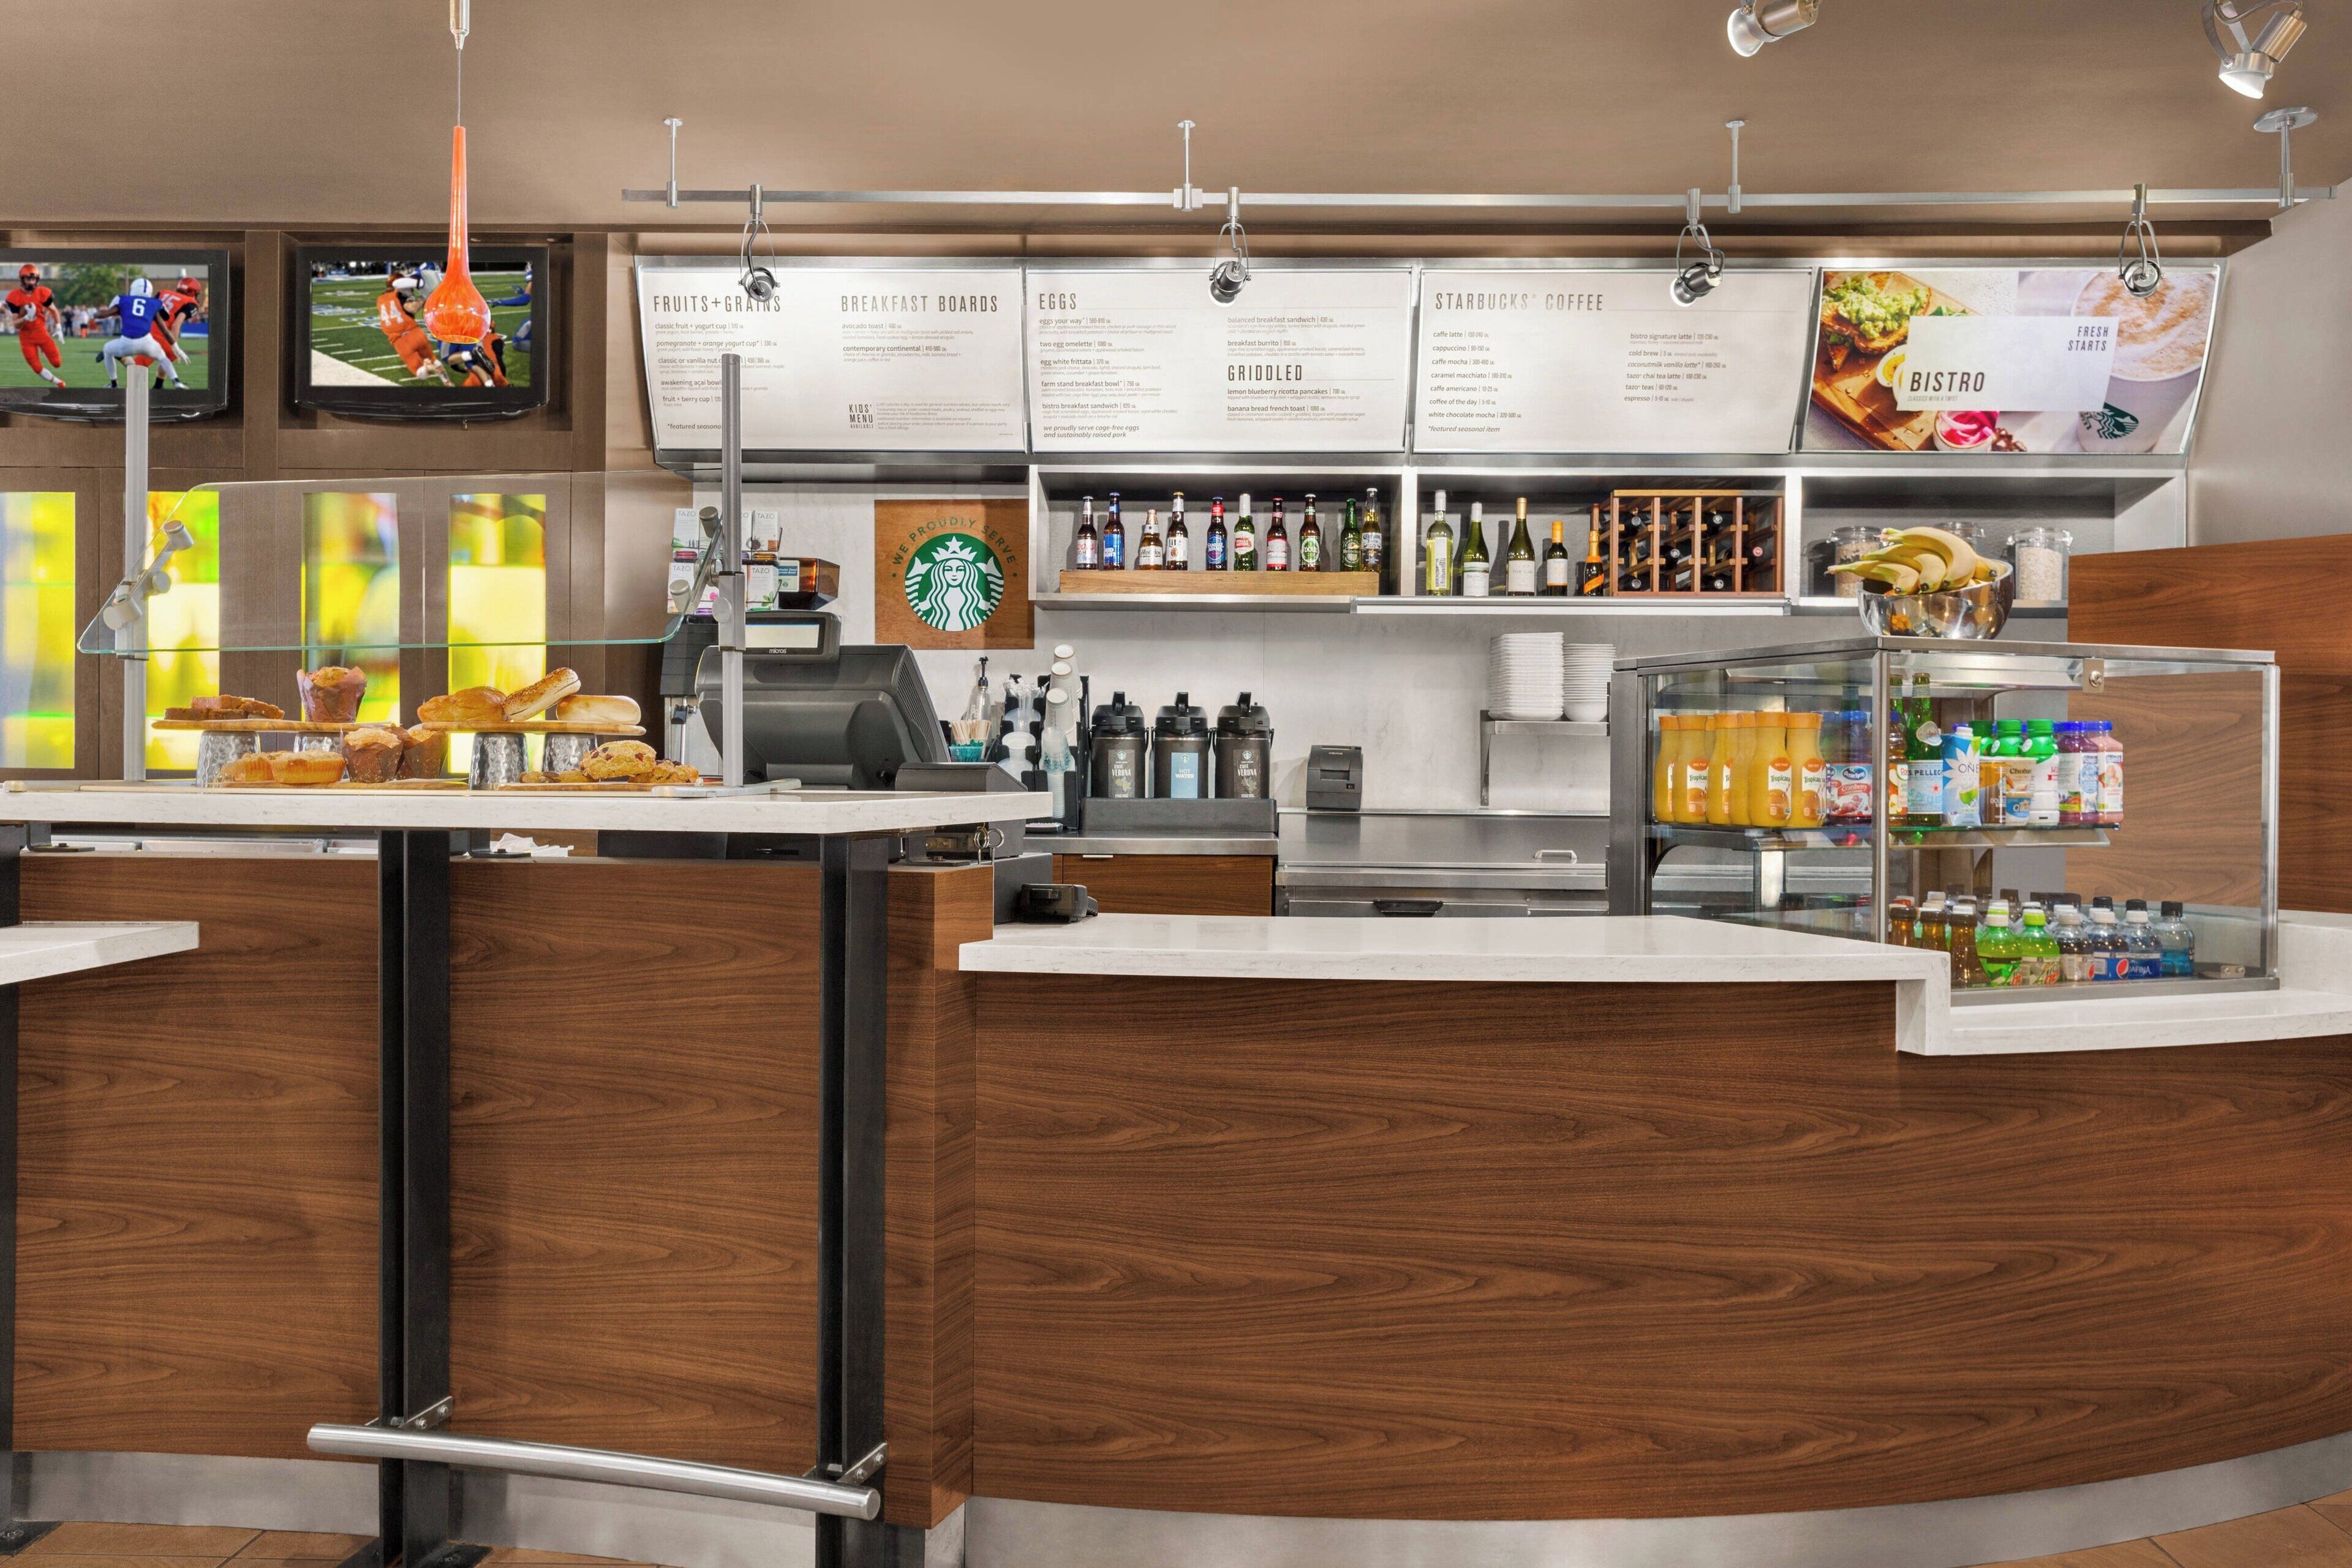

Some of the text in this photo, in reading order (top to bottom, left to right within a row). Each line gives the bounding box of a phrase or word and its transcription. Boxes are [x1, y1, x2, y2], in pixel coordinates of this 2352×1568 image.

[132, 298, 145, 316] 6
[842, 296, 997, 312] BREAKFAST BOARDS
[1039, 293, 1076, 309] EGGS
[1546, 293, 1603, 311] COFFEE
[380, 301, 404, 326] 44
[2078, 326, 2109, 337] FRESH
[2068, 341, 2107, 351] STARTS
[1228, 365, 1302, 380] GRIDDLED
[1910, 372, 1985, 392] BISTRO
[849, 404, 872, 413] KIDS'
[850, 414, 873, 423] MENU
[892, 516, 1016, 565] WE PROUDLY SERVE
[1958, 763, 1980, 774] ONE
